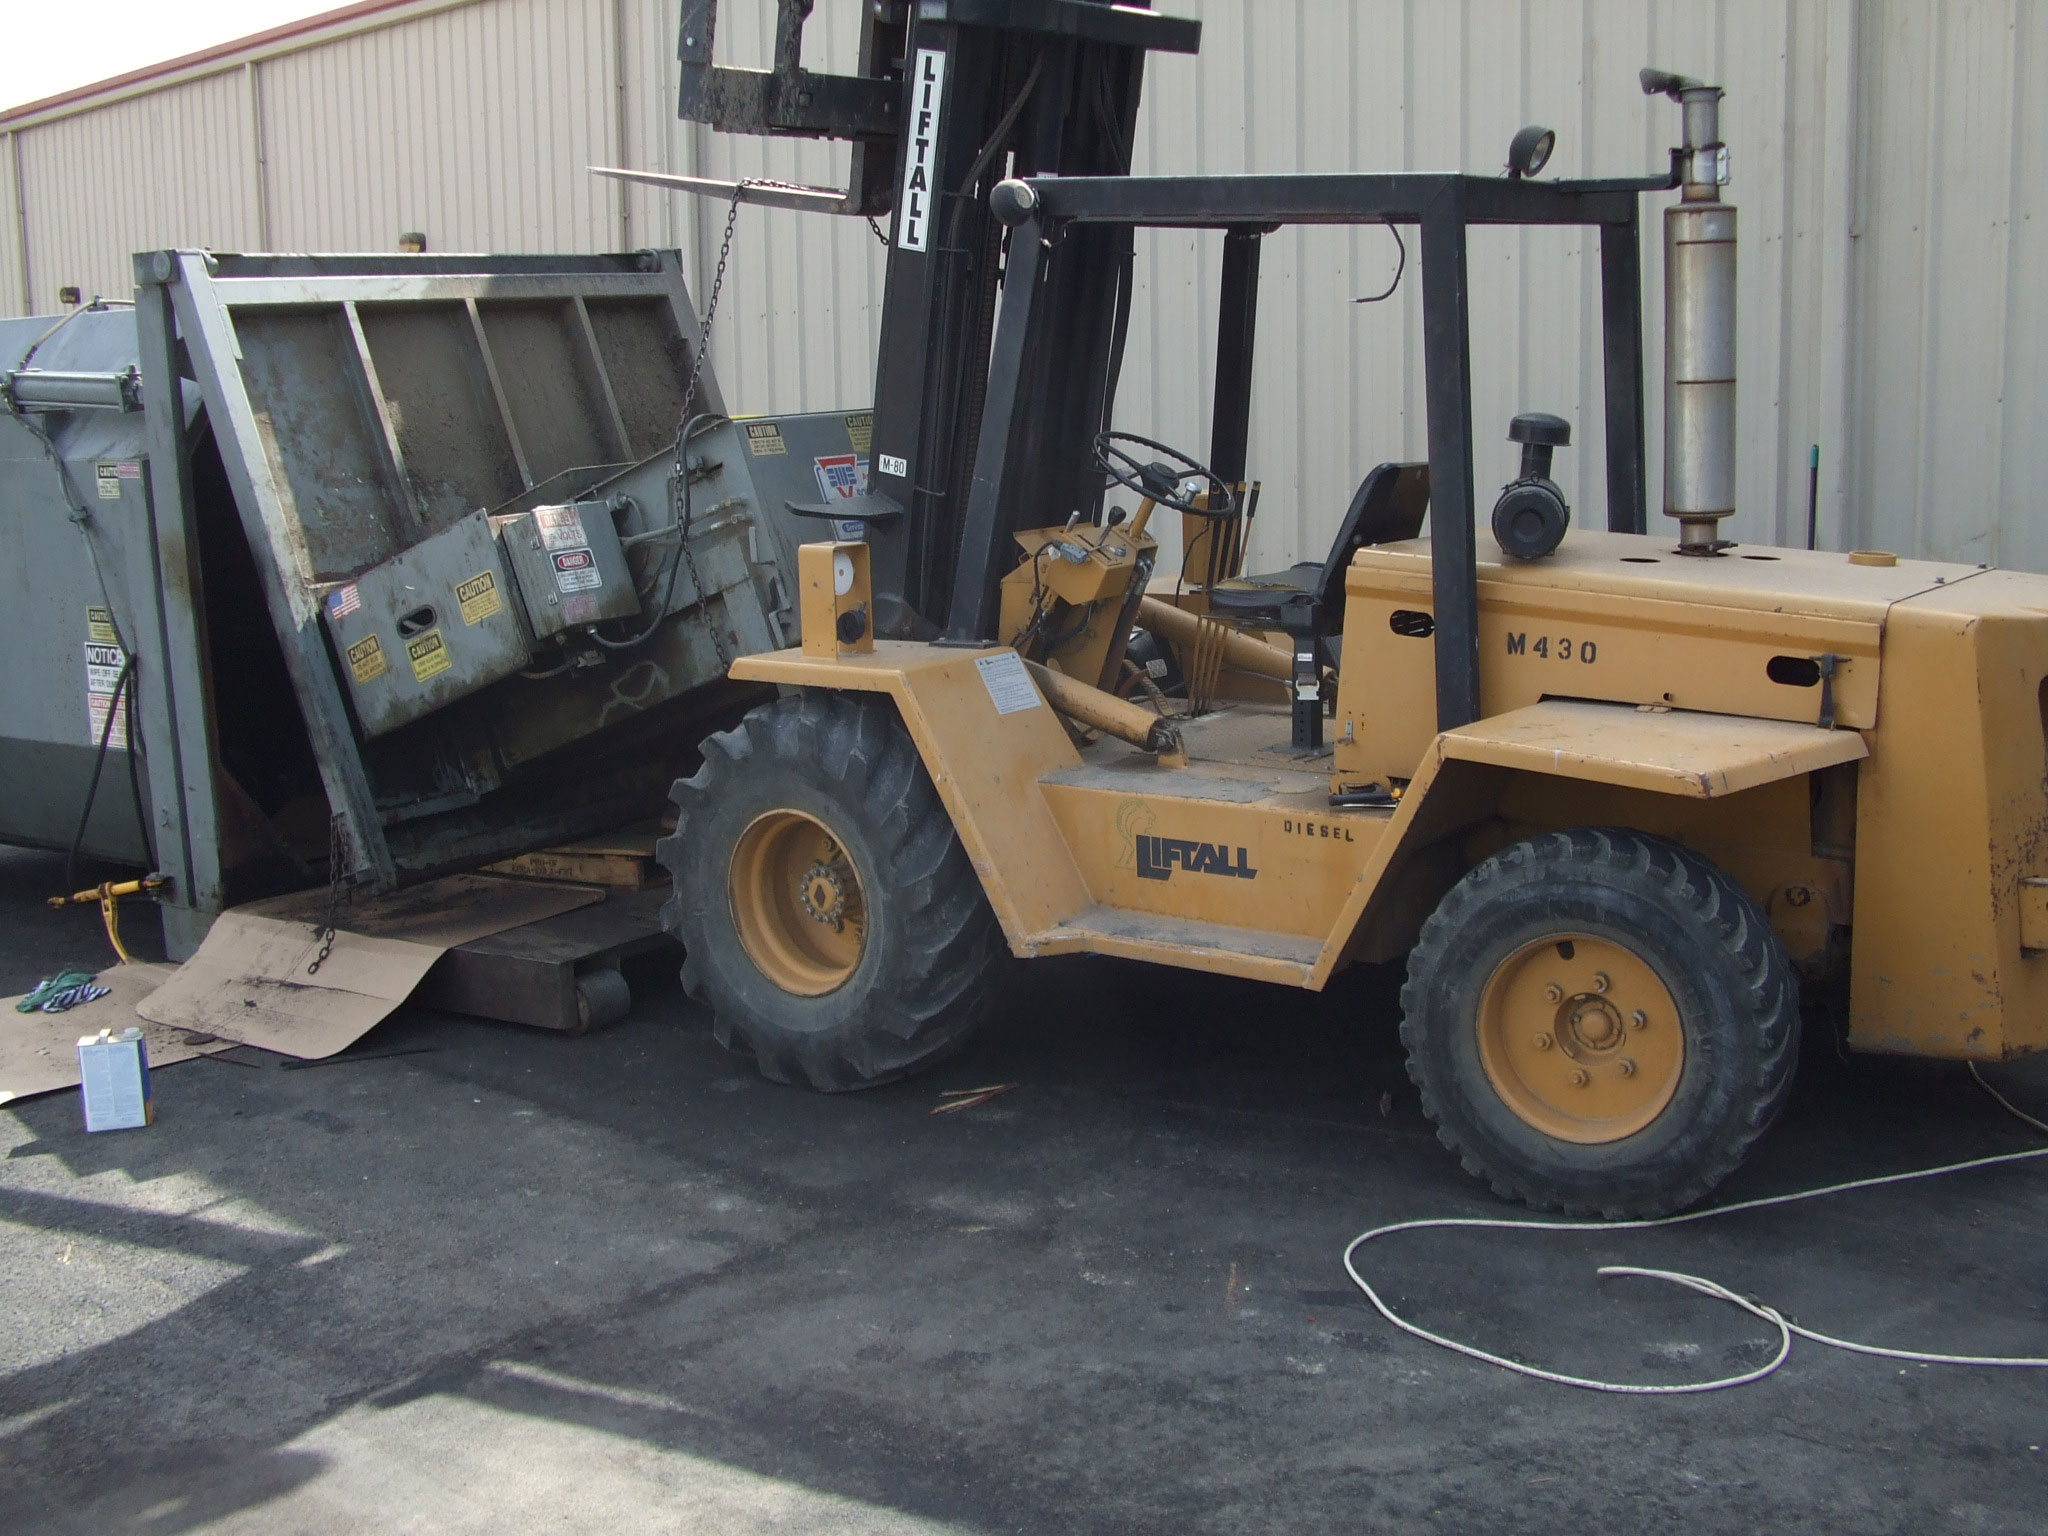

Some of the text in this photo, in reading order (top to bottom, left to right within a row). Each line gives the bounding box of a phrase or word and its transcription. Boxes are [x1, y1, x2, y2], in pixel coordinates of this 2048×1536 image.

[907, 55, 936, 245] LIFTALL
[748, 424, 778, 438] CAUTION
[848, 415, 873, 427] CAUTIO
[882, 457, 905, 474] M-80
[562, 555, 585, 567] DANGER
[459, 574, 493, 601] CAUTION
[87, 646, 125, 666] NOTICE
[350, 638, 378, 662] CAUTION
[411, 636, 441, 659] CAUTION
[1284, 820, 1355, 842] DIESEL
[1135, 834, 1258, 881] LIFTALL
